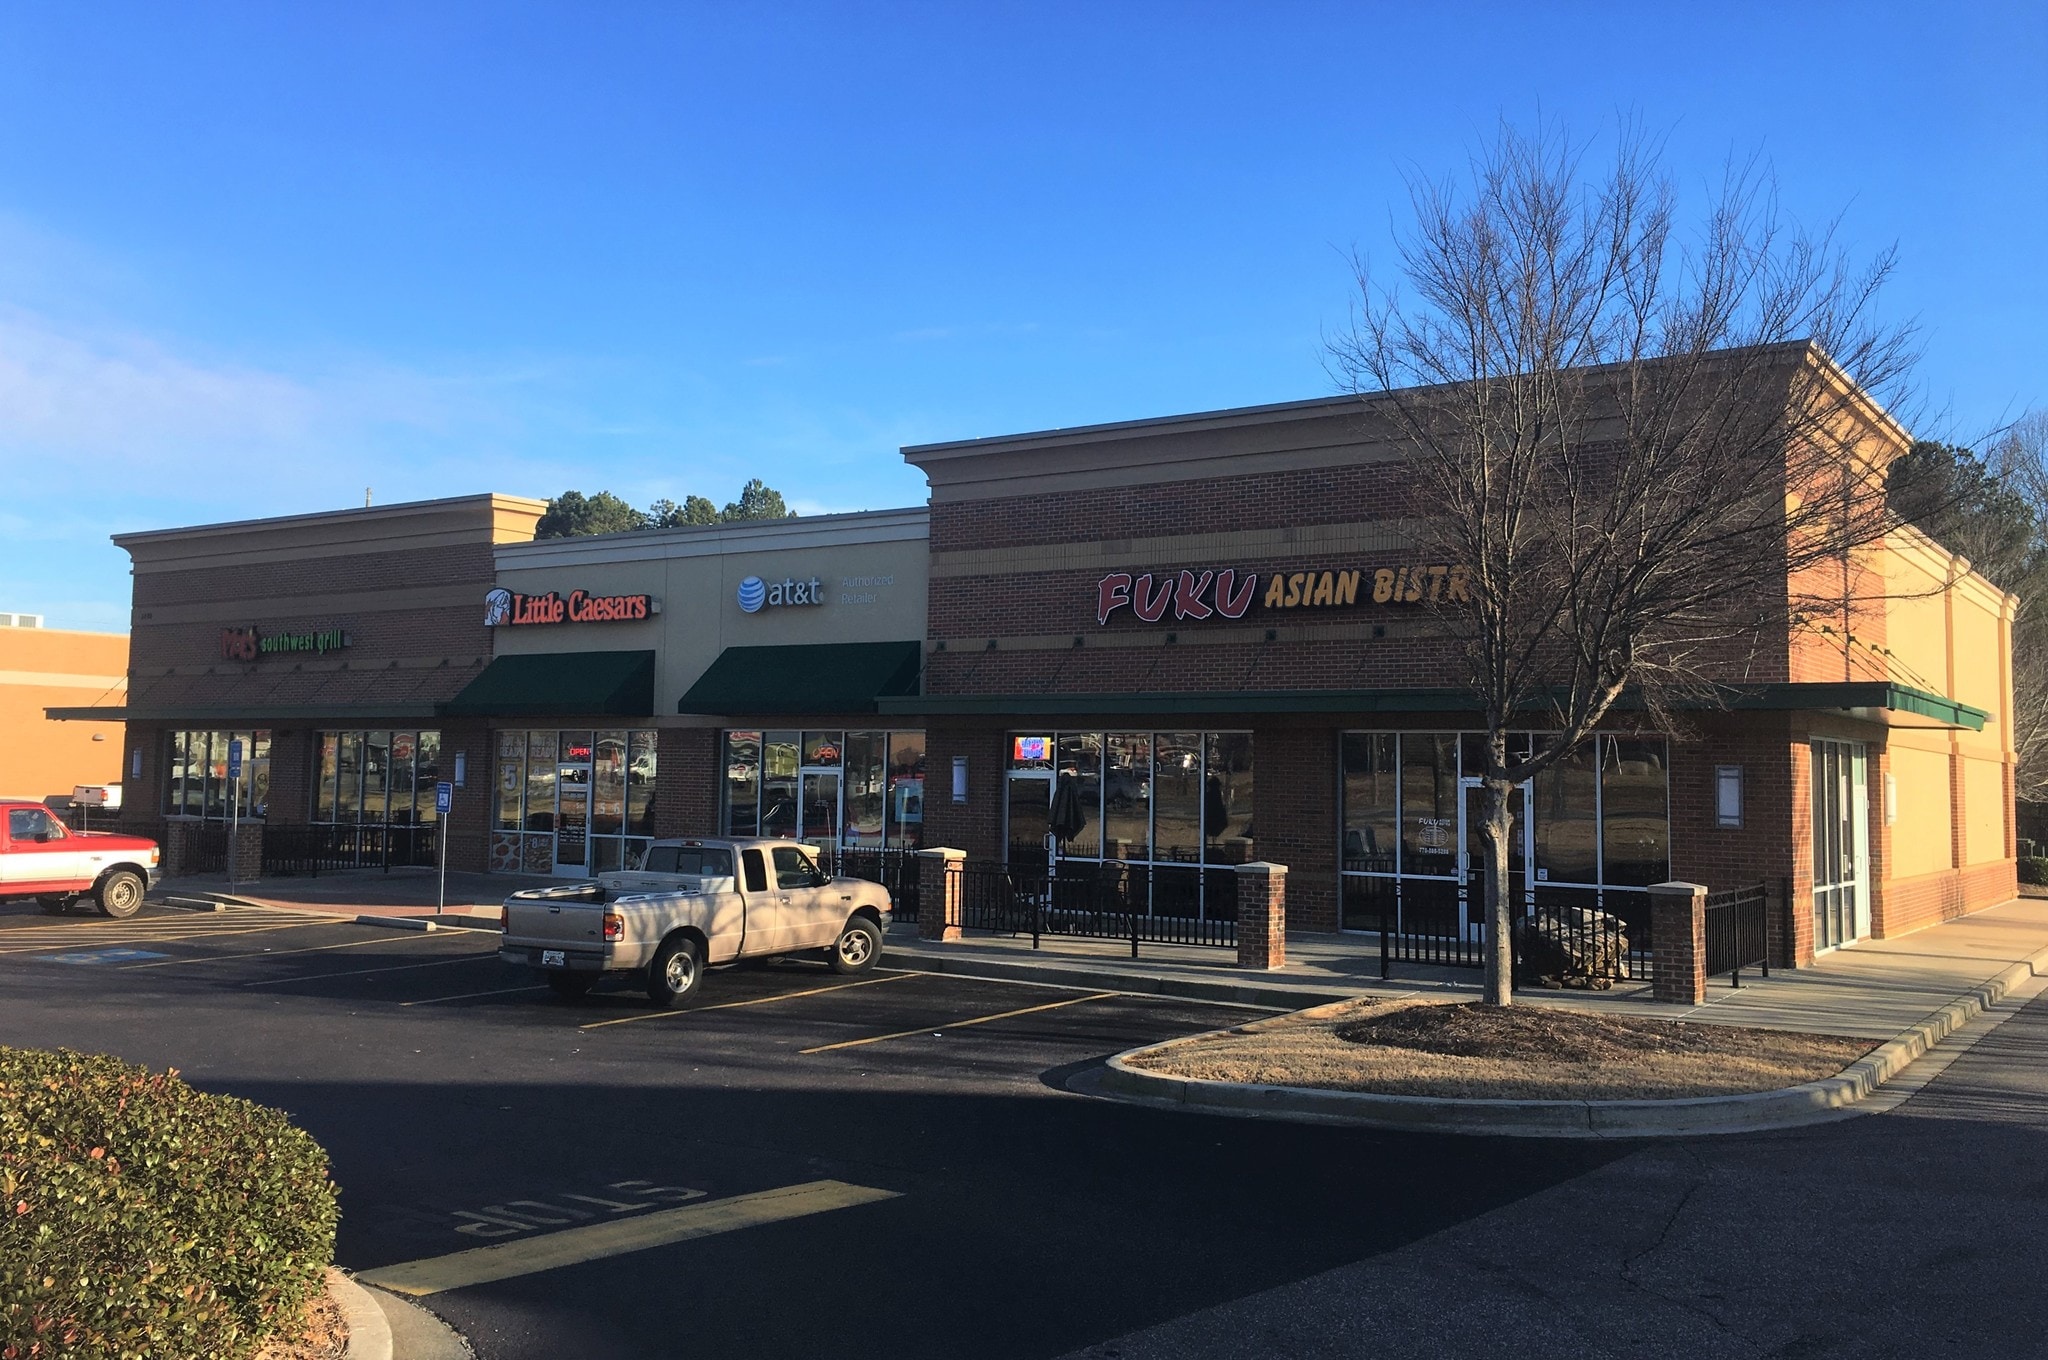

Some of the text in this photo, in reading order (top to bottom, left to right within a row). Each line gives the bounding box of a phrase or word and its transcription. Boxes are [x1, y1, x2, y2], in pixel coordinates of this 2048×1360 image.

[768, 577, 821, 606] at&t
[842, 574, 894, 588] Authorized
[1098, 564, 1482, 625] FUKU ASIAN BISTR
[512, 589, 647, 624] Little Caesars
[841, 592, 878, 605] Retailer
[261, 632, 315, 653] southwest
[317, 629, 342, 656] grill
[569, 747, 591, 756] OPEN
[813, 746, 839, 759] OPEN
[453, 1178, 709, 1238] STOP
